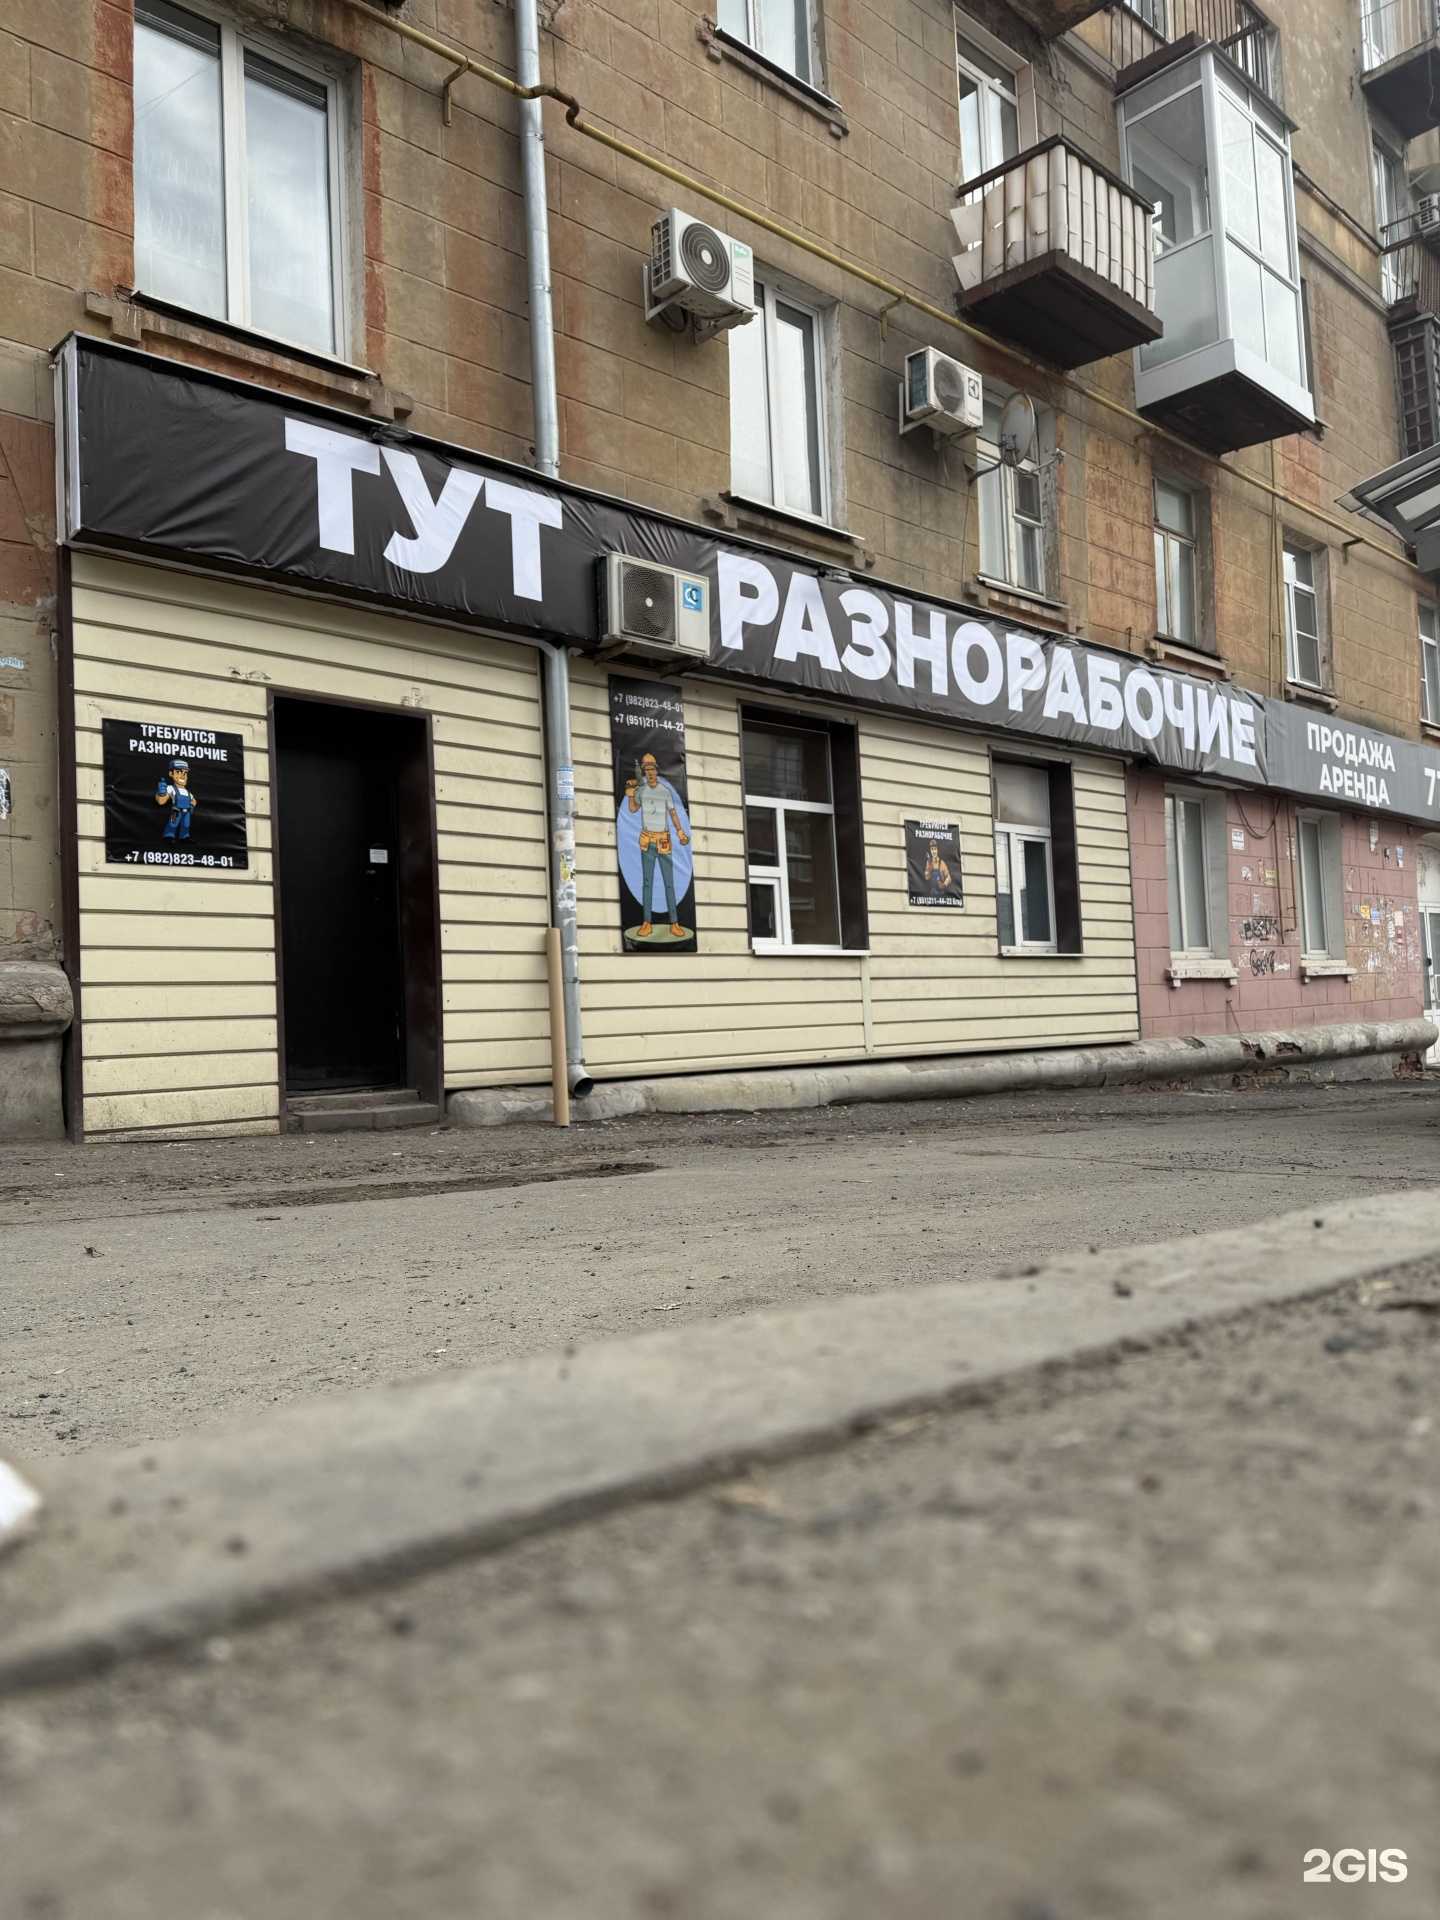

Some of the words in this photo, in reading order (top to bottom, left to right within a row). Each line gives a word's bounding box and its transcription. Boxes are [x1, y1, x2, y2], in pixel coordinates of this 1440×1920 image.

[285, 416, 563, 602] ТУТ
[716, 550, 1257, 767] РАЗНОРАБОЧИЕ
[615, 713, 624, 723] +7
[140, 724, 216, 745] ТРЕБУЮТСЯ
[129, 739, 228, 762] РАЗНОРАБОЧИЕ
[1307, 721, 1397, 773] ПРОДАЖА
[1319, 763, 1391, 808] АРЕНДА
[125, 851, 140, 863] +7
[143, 852, 234, 868] (982)823-48-01
